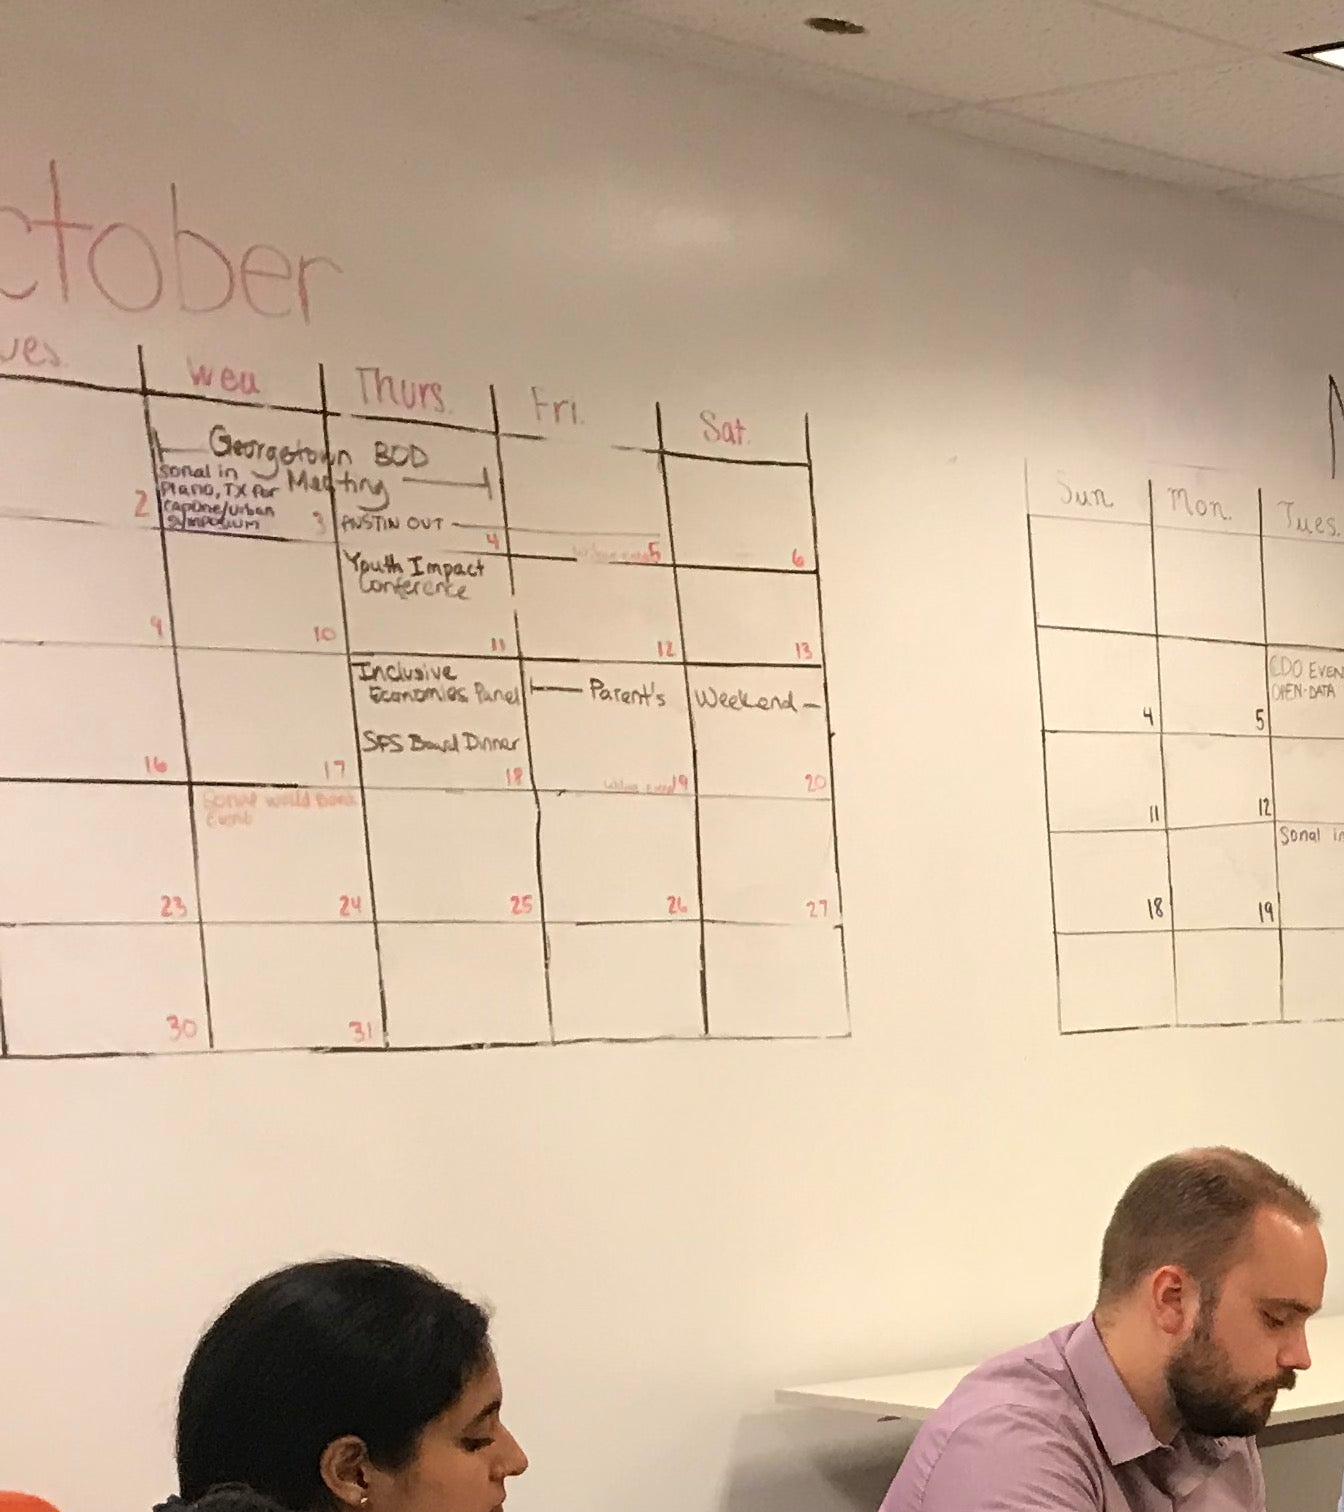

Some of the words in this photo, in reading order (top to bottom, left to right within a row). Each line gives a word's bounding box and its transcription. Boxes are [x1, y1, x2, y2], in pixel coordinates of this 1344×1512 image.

[209, 424, 353, 480] Georgetown
[218, 463, 239, 480] in
[224, 482, 247, 499] TX
[135, 489, 149, 518] 2
[1167, 487, 1232, 521] Mon.
[1278, 500, 1341, 537] Tues.
[341, 514, 401, 532] AUSTIN
[406, 515, 445, 531] OUT
[487, 532, 500, 550] 4
[647, 540, 662, 565] 5
[791, 548, 805, 568] 6
[343, 548, 404, 577] Youth
[410, 555, 486, 580] Impact
[150, 615, 163, 639] 9
[313, 625, 338, 643] 10
[492, 636, 507, 652] 11
[656, 640, 674, 659] 12
[794, 641, 813, 660] 13
[356, 661, 458, 683] Inclusive
[473, 680, 521, 705] Panel
[589, 677, 668, 709] Parent's
[695, 688, 798, 713] Weekend
[1143, 706, 1154, 727] 4
[1255, 708, 1266, 731] 5
[462, 731, 520, 752] Dinner
[144, 755, 169, 775] 16
[323, 759, 346, 780] 17
[804, 772, 827, 792] 20
[1149, 804, 1160, 822] 11
[1258, 797, 1273, 817] 12
[160, 895, 188, 918] 23
[339, 894, 363, 918] 24
[510, 894, 533, 915] 25
[666, 895, 688, 915] 26
[806, 899, 829, 918] 27
[1147, 896, 1164, 920] 18
[1258, 900, 1275, 923] 19
[166, 1014, 198, 1042] 30
[348, 1020, 373, 1043] 31
